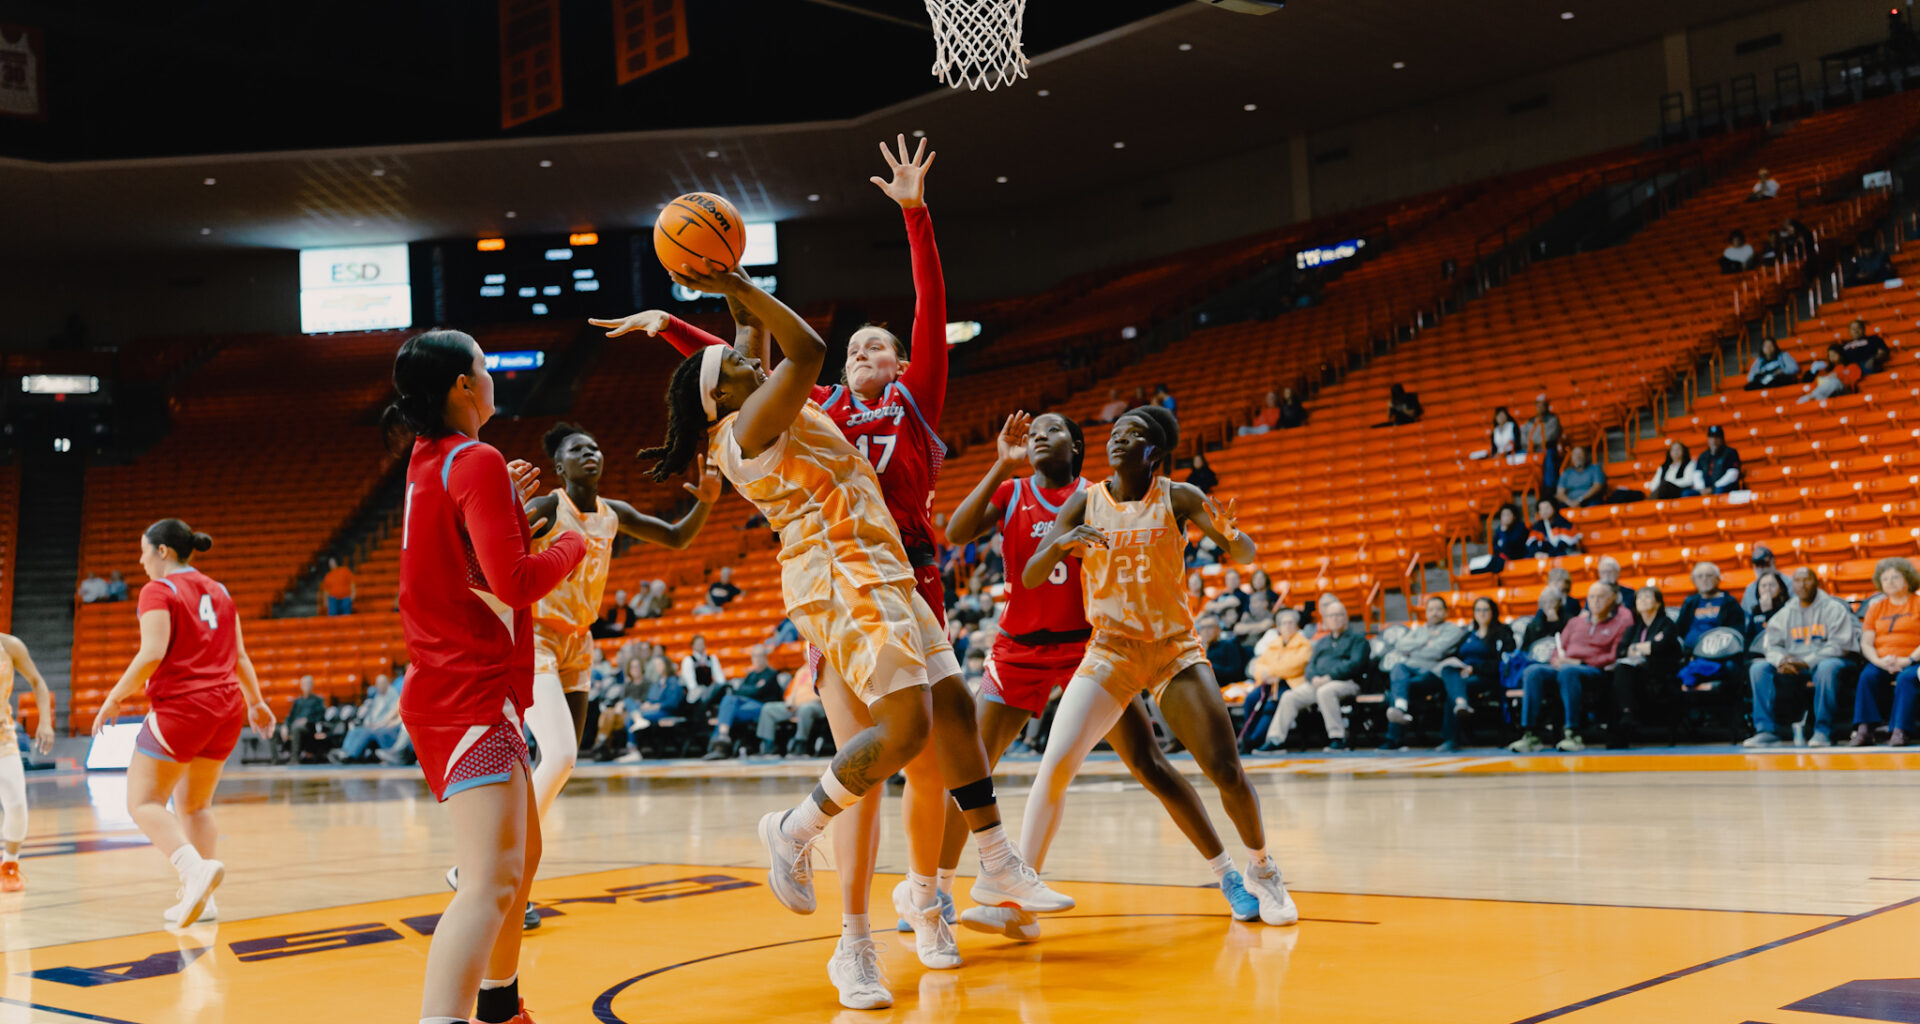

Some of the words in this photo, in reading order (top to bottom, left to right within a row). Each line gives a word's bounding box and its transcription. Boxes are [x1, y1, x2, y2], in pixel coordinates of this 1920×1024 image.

[331, 261, 381, 283] ESD
[855, 434, 897, 474] 17
[1114, 553, 1152, 584] 22
[198, 593, 218, 629] 4
